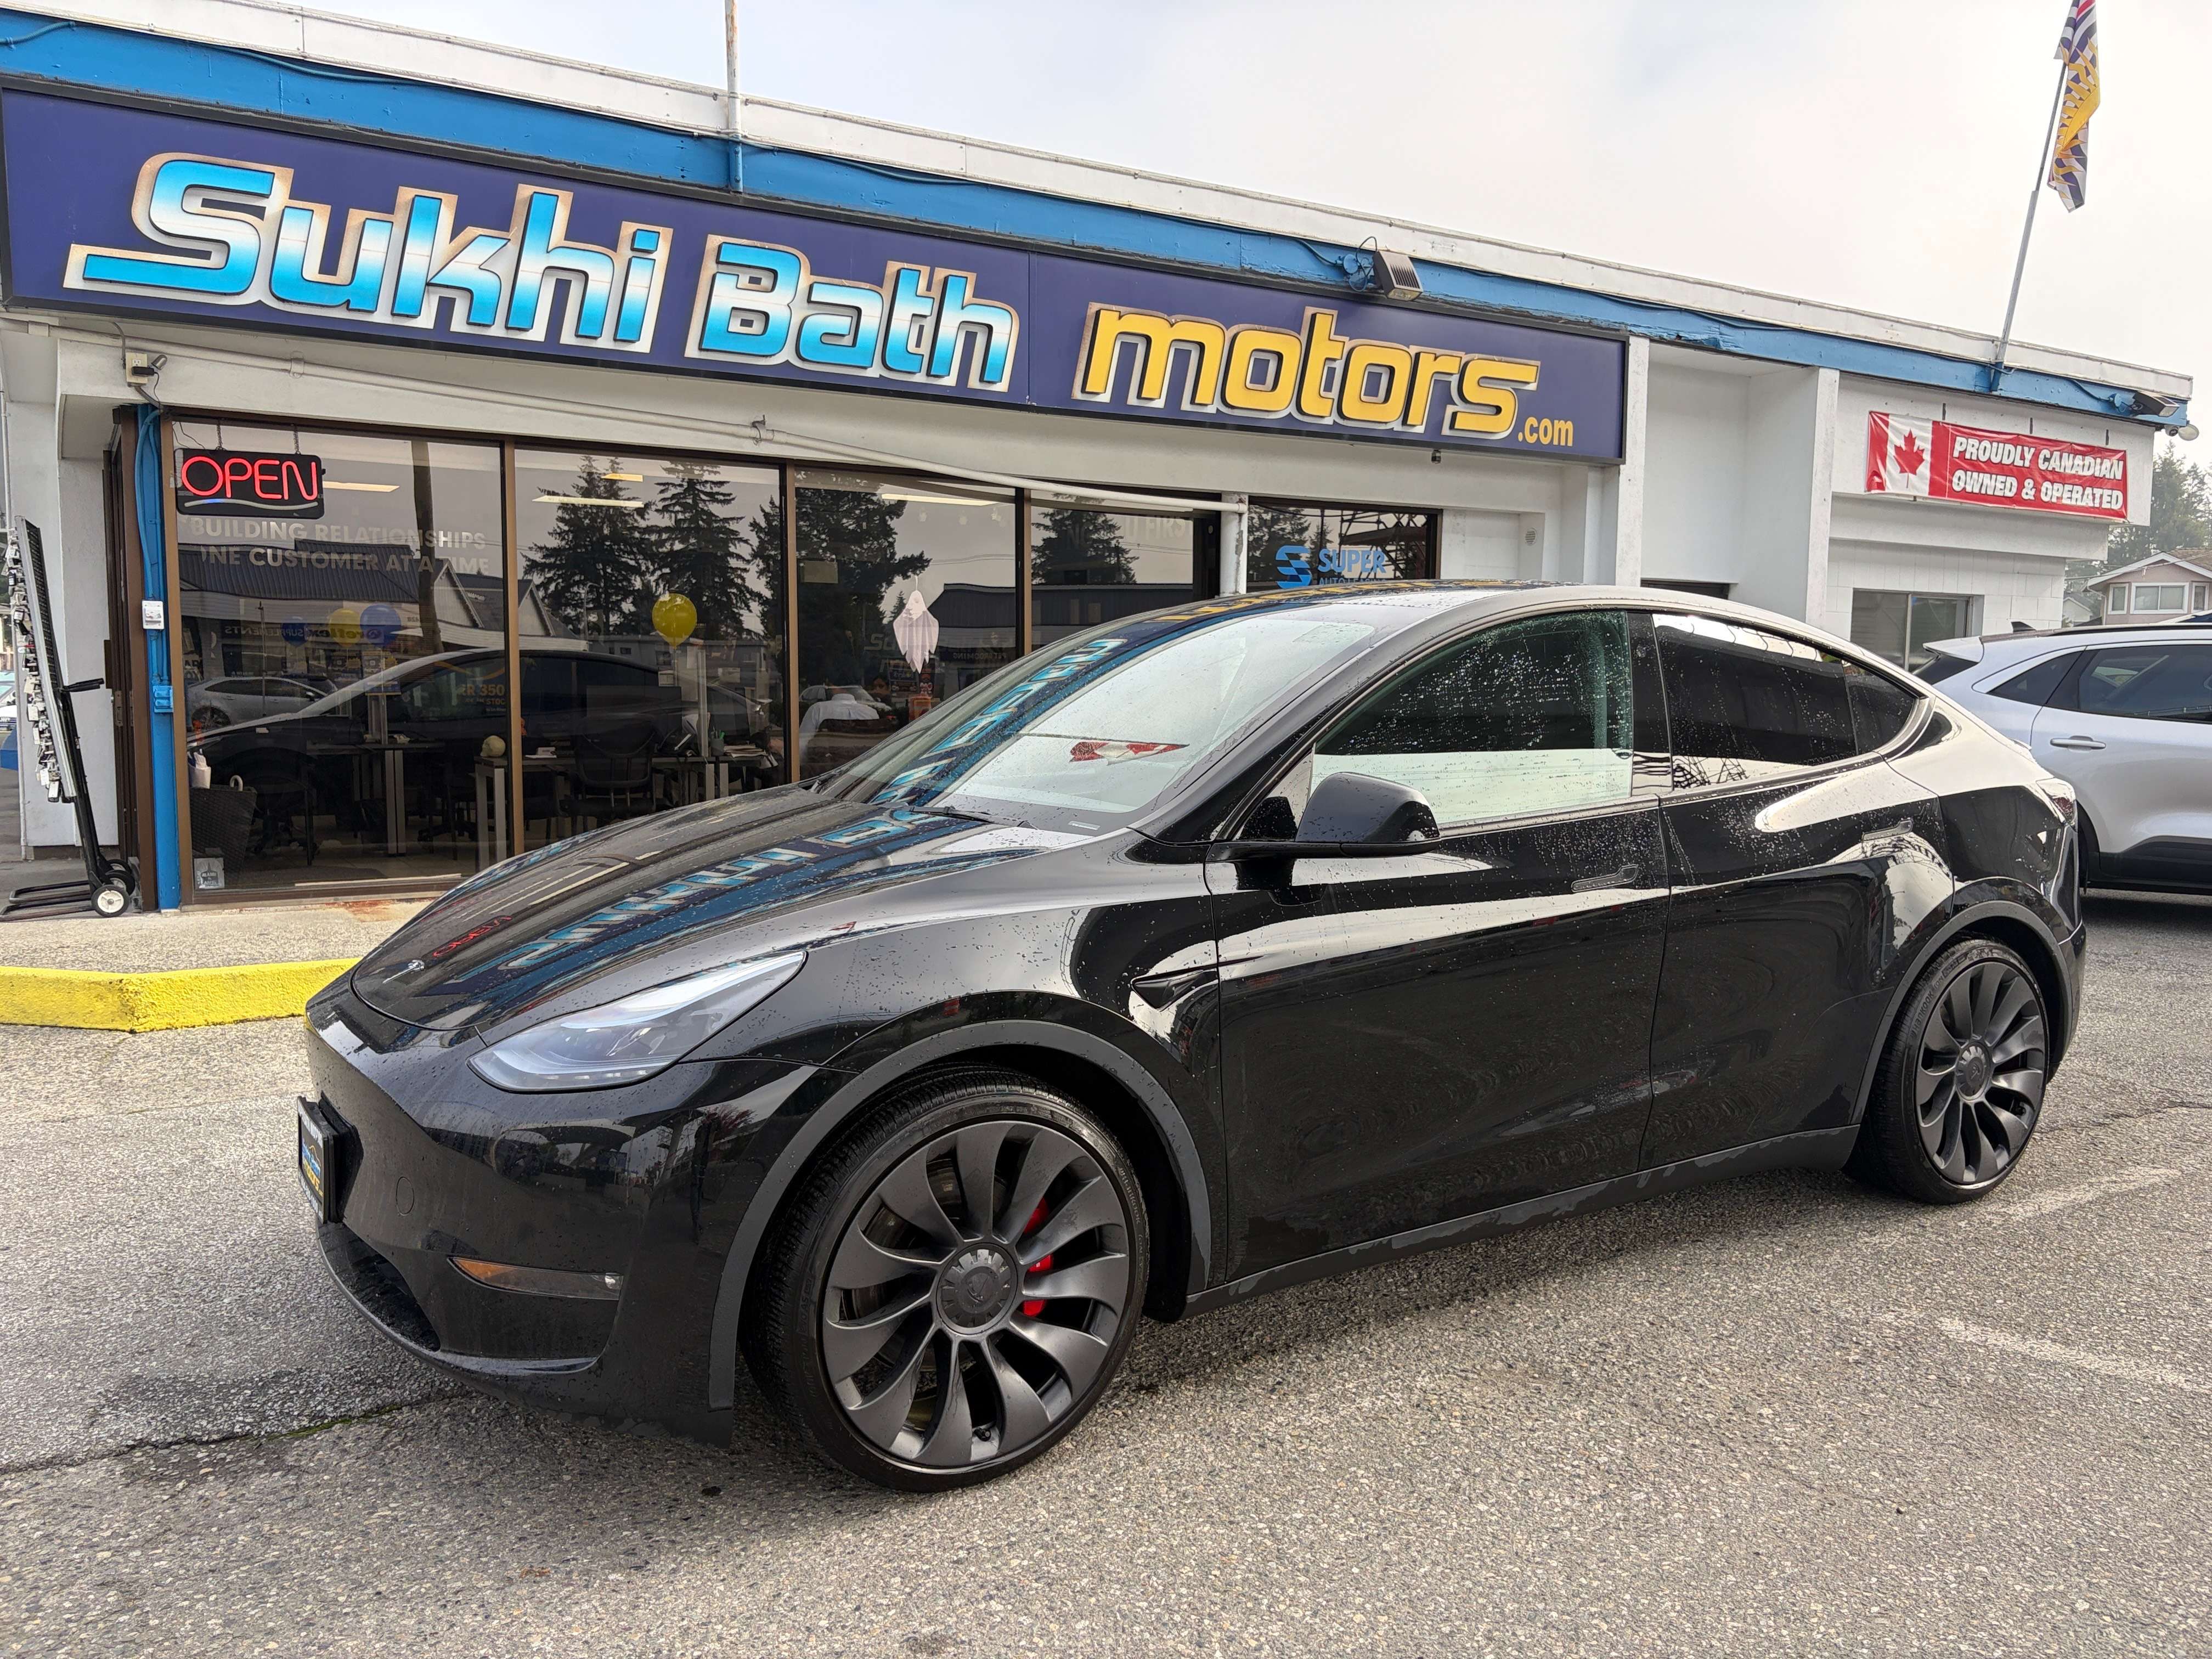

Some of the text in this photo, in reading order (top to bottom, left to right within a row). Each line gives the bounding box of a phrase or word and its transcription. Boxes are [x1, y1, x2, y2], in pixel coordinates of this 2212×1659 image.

[64, 152, 1574, 447] Sukhi Bath motors .com
[180, 455, 318, 501] OPEN
[1952, 436, 2124, 481] PROUDLY CANADIAN
[1951, 469, 2124, 510] OWNED & OPERATED
[315, 524, 487, 550] RELATIONSHIPS
[249, 548, 379, 570] CUSTOMER
[386, 554, 412, 572] AT
[417, 555, 435, 573] A
[441, 556, 489, 574] IME
[1317, 548, 1387, 573] SUPER
